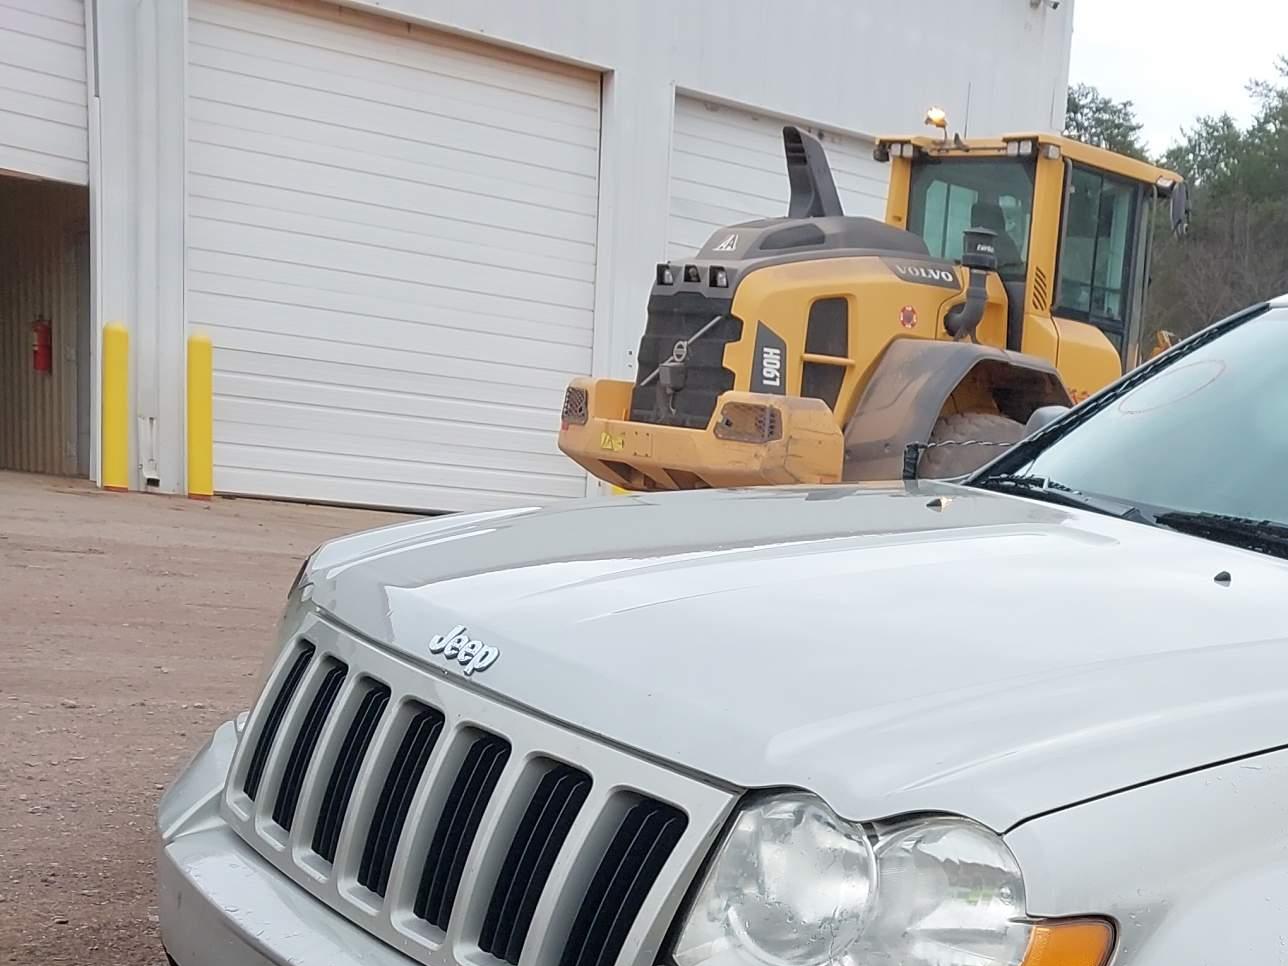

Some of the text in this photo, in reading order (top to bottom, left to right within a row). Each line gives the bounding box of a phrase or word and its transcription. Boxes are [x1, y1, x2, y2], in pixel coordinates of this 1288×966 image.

[895, 264, 953, 282] VOLVO
[762, 346, 781, 387] L90H
[428, 624, 500, 677] Jeep
